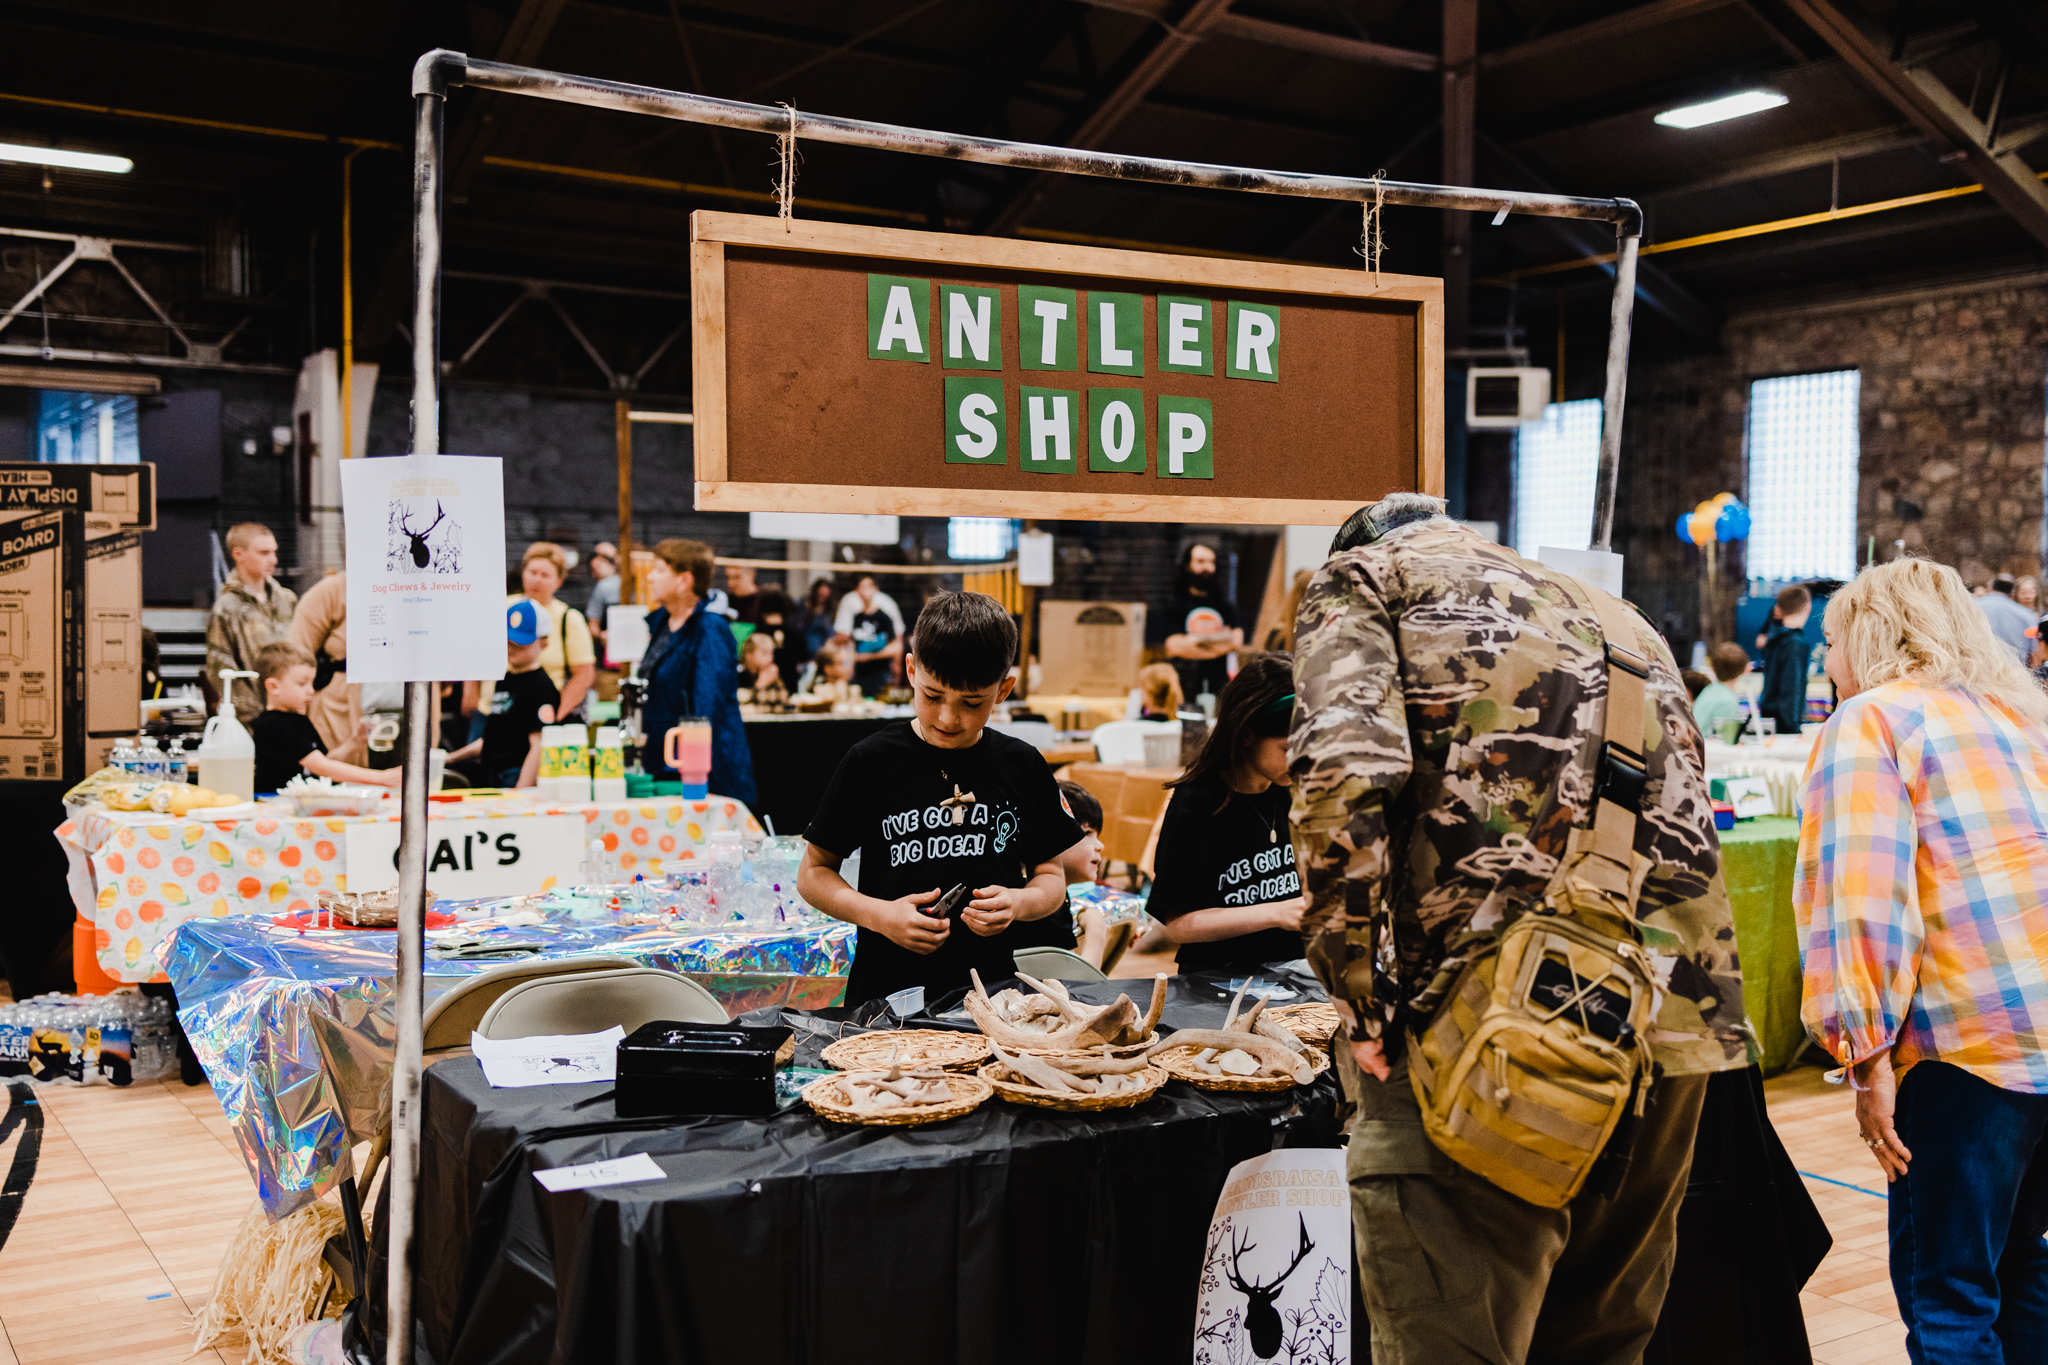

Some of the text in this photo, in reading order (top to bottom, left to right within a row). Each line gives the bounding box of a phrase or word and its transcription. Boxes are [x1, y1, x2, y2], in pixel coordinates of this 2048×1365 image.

[564, 81, 631, 98] CHARLOTTE
[888, 132, 899, 140] PSI
[877, 285, 1276, 375] ANTLER
[955, 393, 1207, 475] SHOP
[7, 487, 78, 504] DISPLAY
[2, 528, 55, 556] BOARD
[372, 581, 471, 594] Dog Chews & Jewelry
[881, 803, 989, 841] I'VE GO A
[890, 833, 987, 868] BIG IDEA!
[1252, 846, 1282, 874] GOT
[1283, 843, 1296, 866] A
[1259, 870, 1301, 901] IDEA!
[1213, 1188, 1348, 1219] ANTLER SHOP
